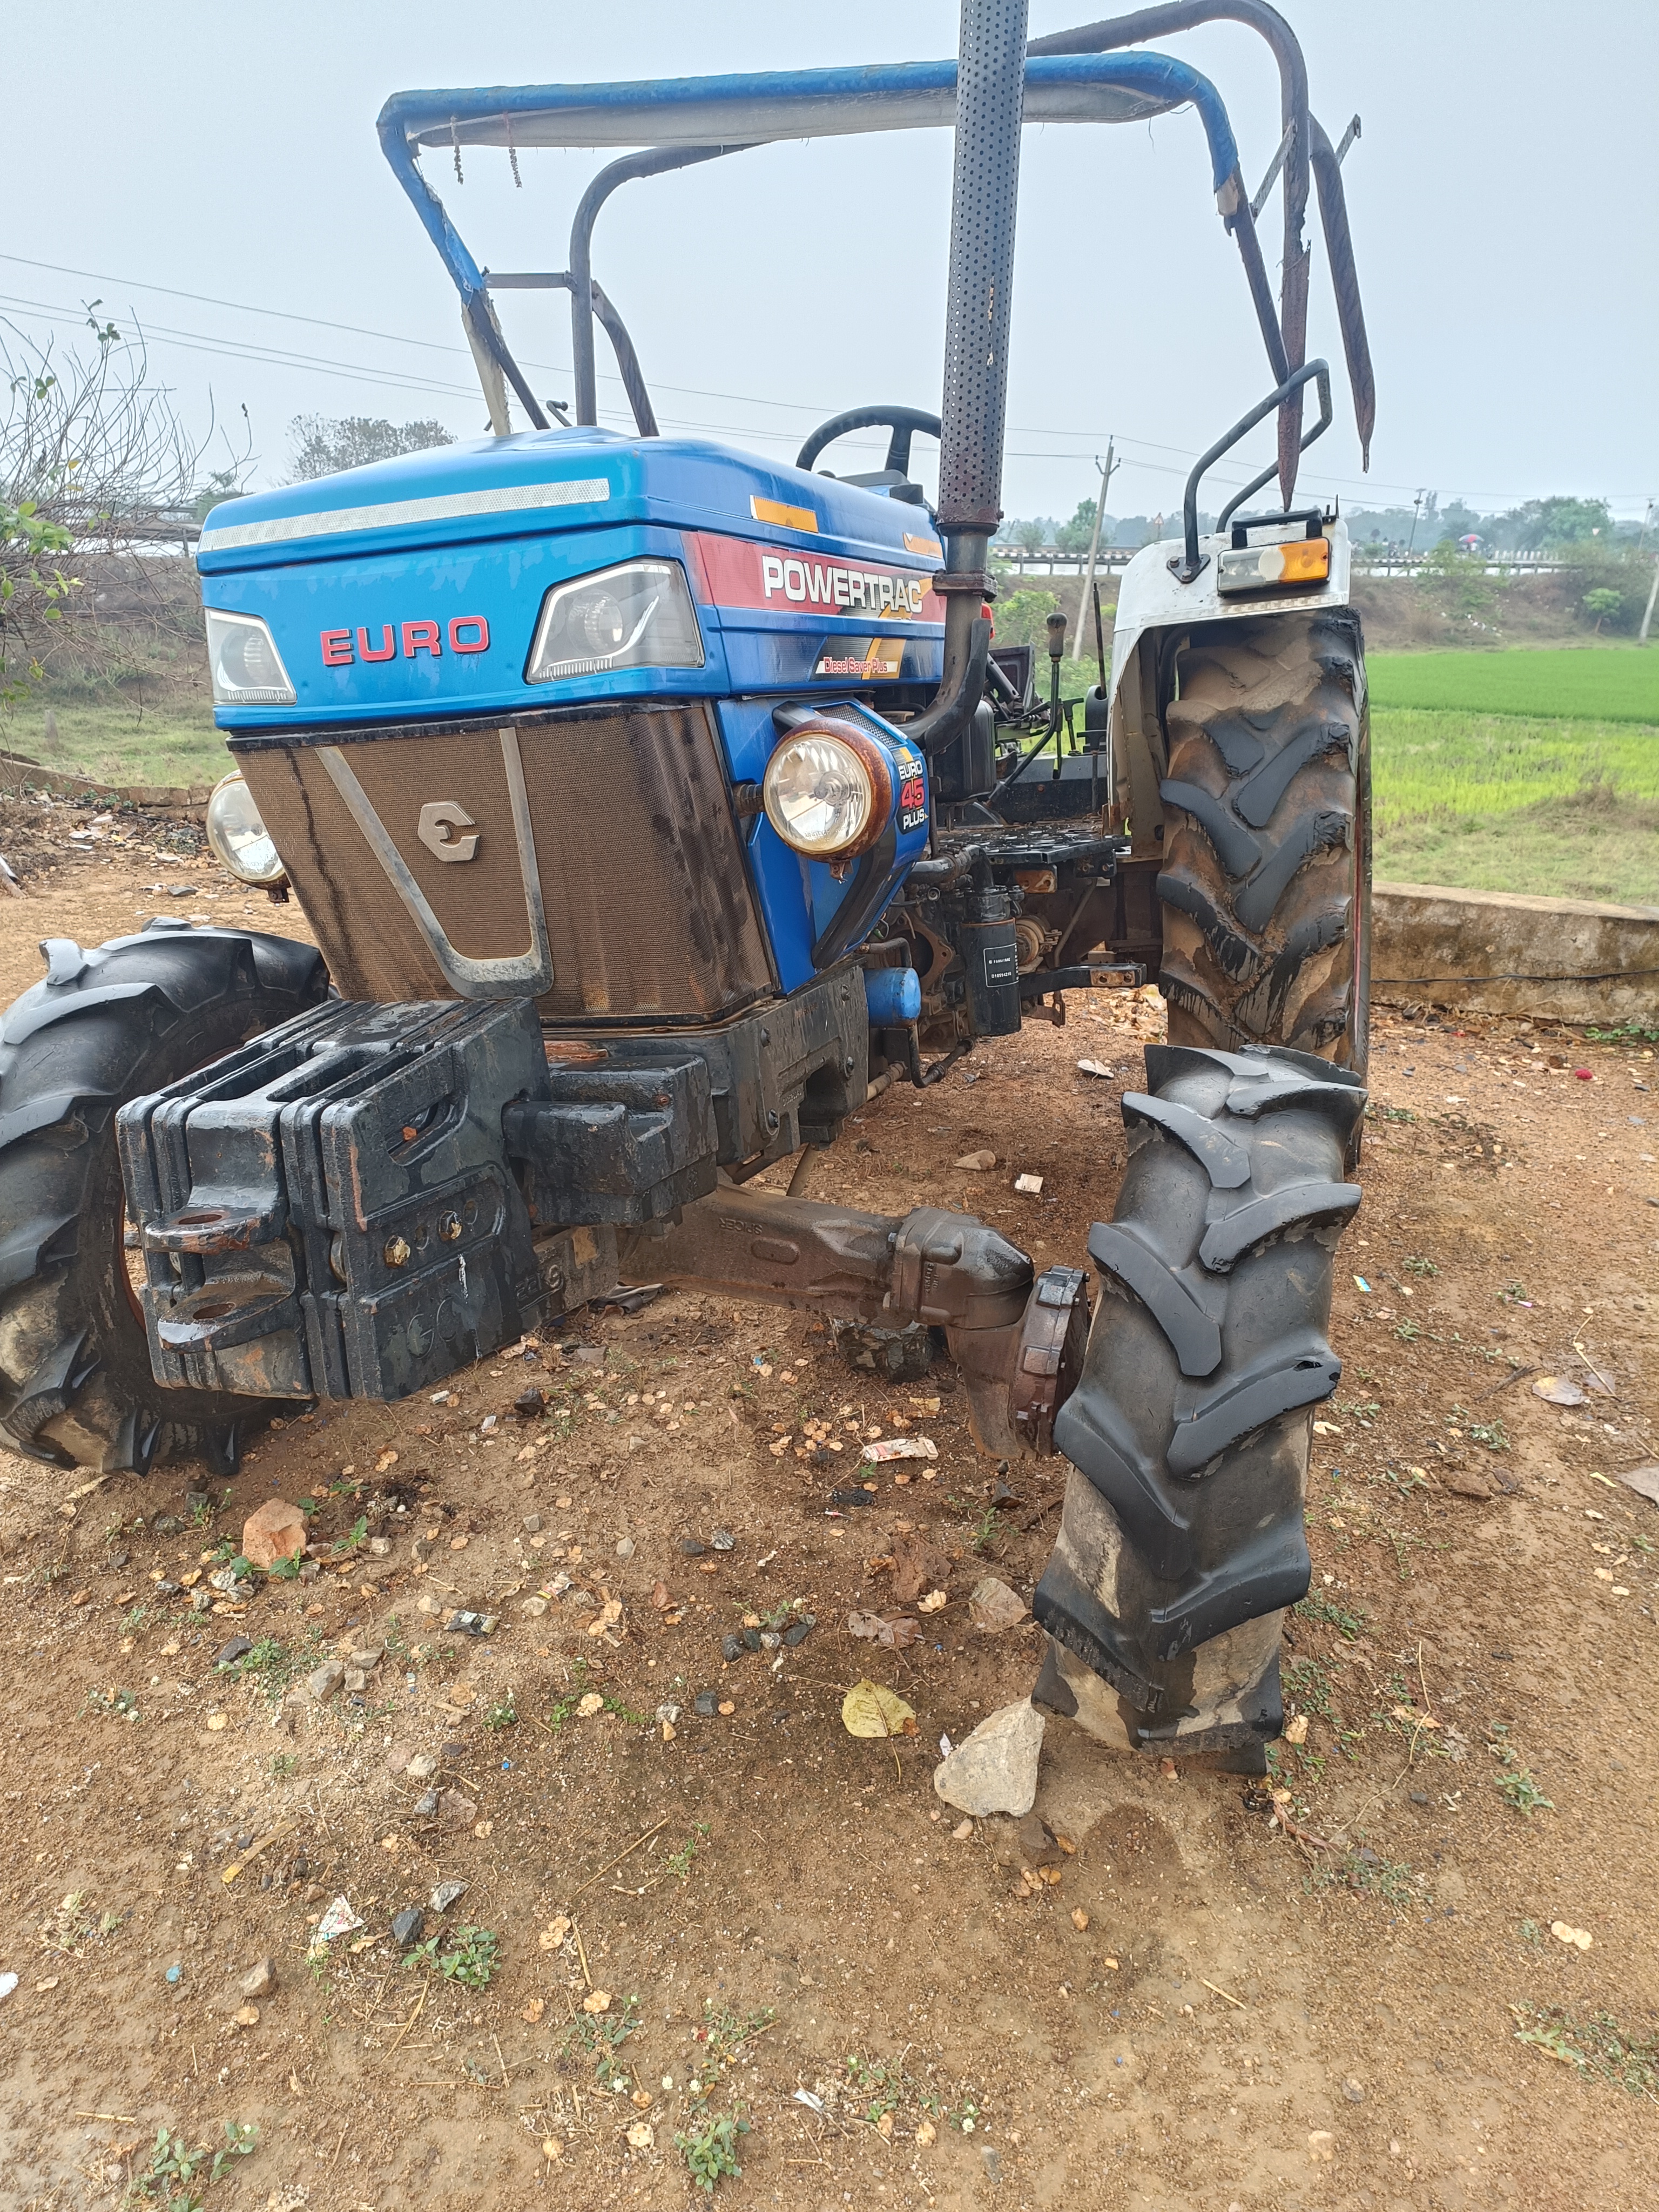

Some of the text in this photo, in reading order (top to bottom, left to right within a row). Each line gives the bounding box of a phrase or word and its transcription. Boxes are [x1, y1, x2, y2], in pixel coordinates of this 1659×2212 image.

[762, 556, 923, 613] POWERTRAC
[320, 615, 490, 665] EURO
[824, 657, 888, 673] Diesel Saver Plus
[898, 760, 923, 780] EURO
[901, 778, 925, 809] 45
[903, 808, 925, 830] PLUS
[718, 1217, 763, 1235] SPICER
